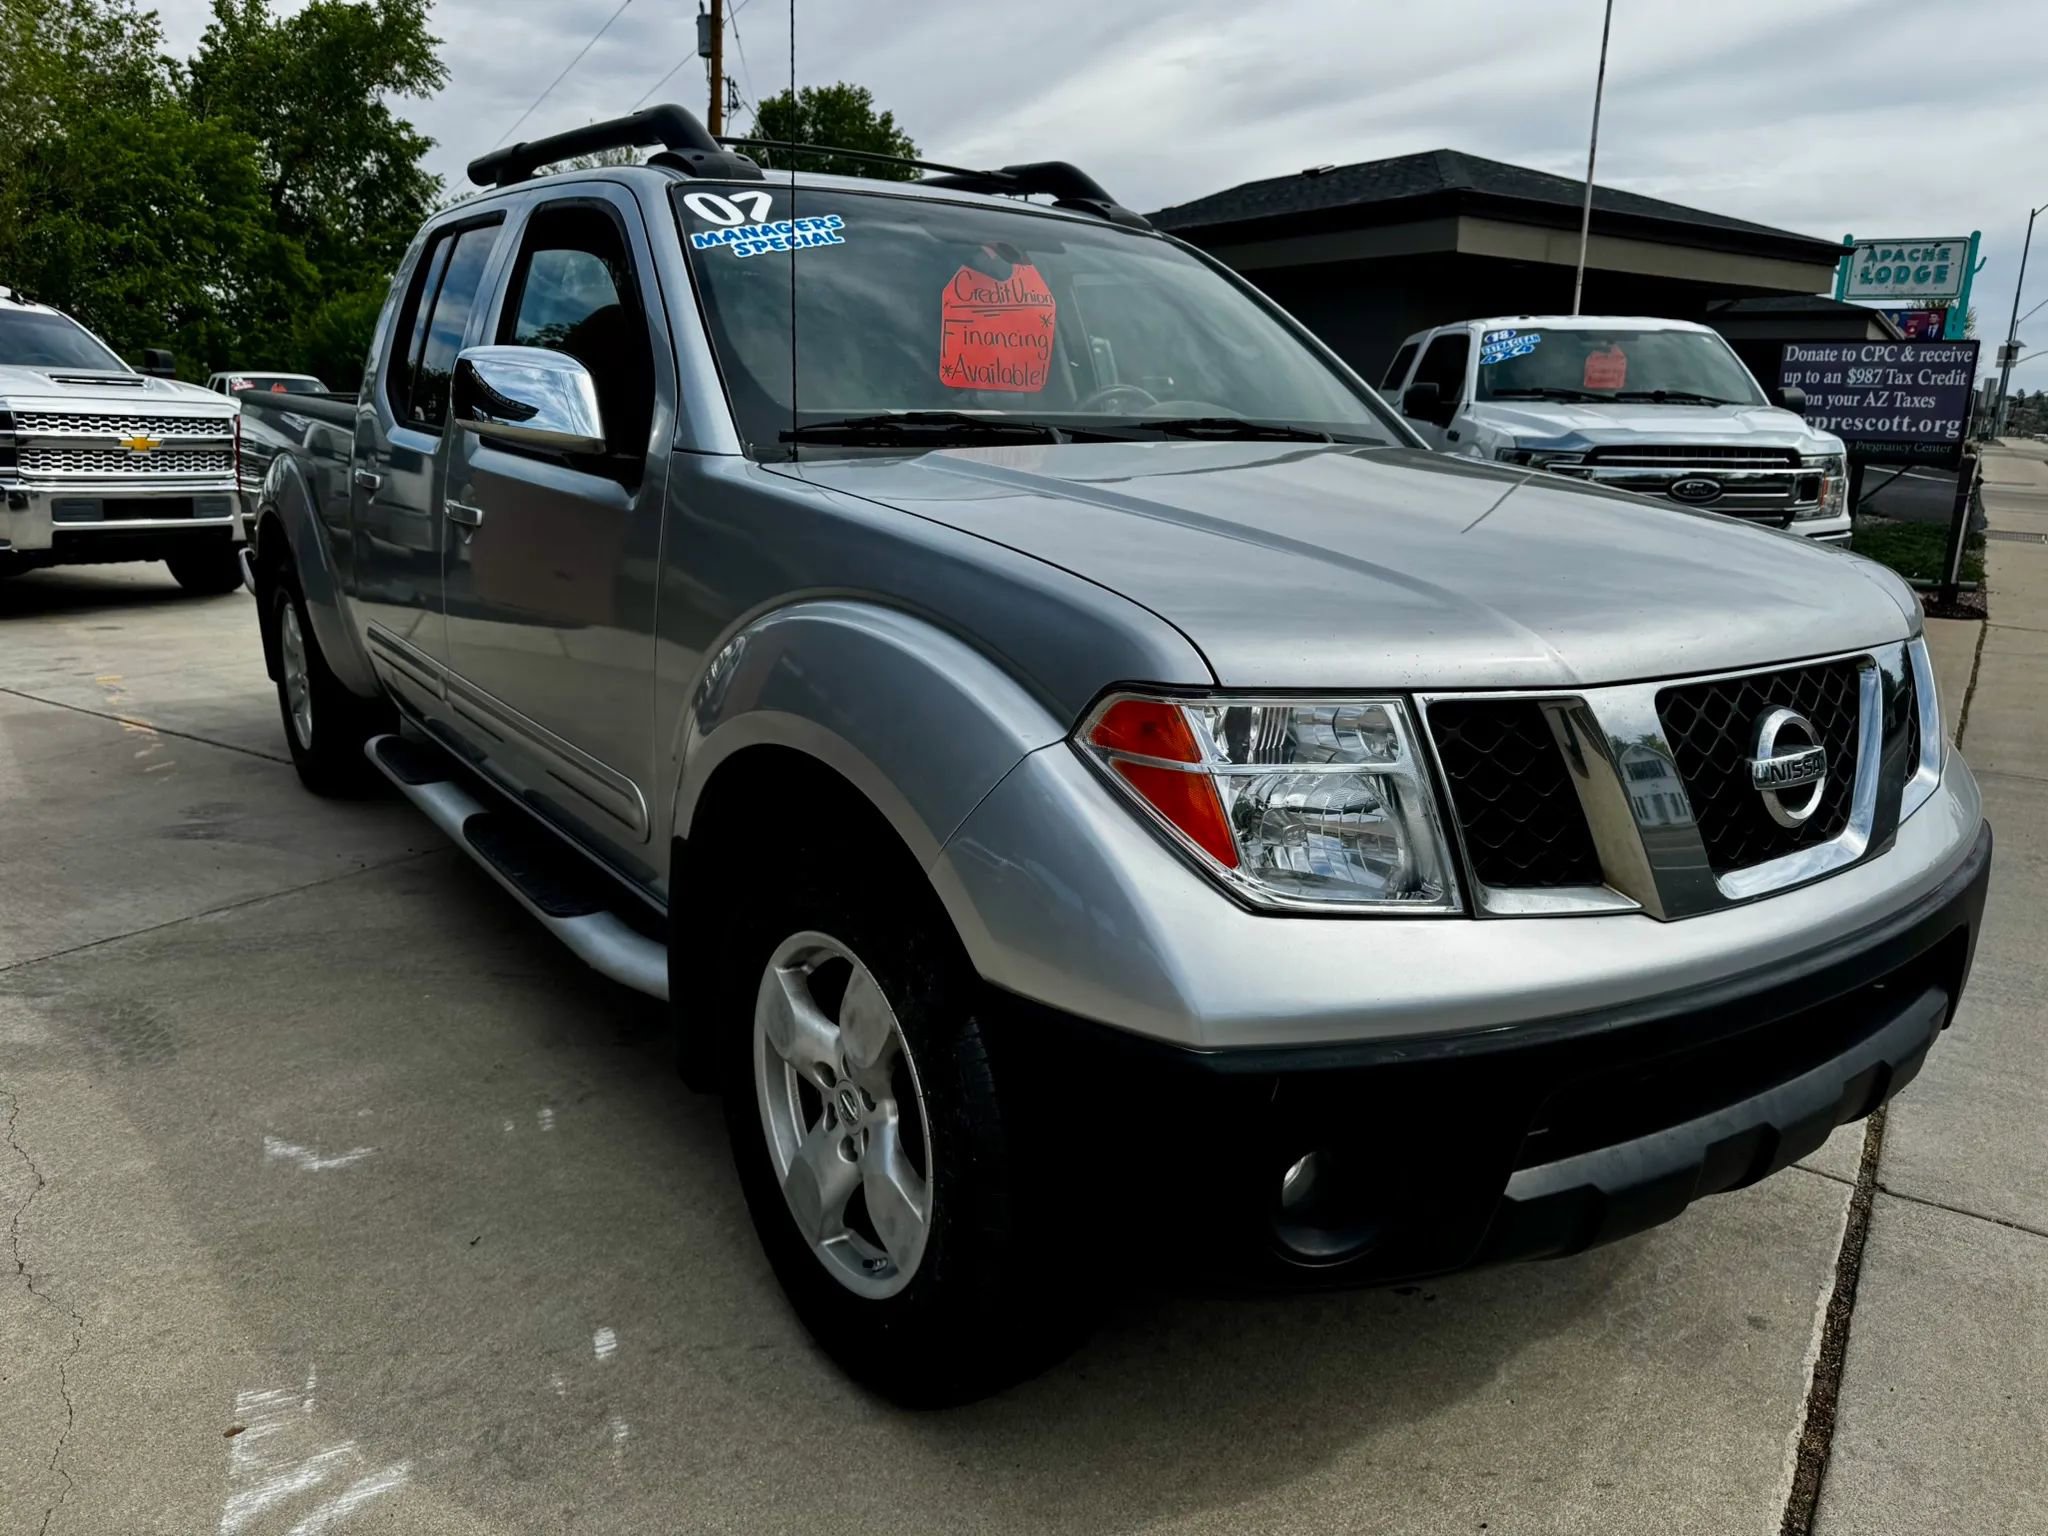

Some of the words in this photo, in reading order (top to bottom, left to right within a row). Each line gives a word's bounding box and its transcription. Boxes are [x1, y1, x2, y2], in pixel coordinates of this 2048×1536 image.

[683, 191, 772, 226] 07
[691, 214, 845, 249] MANAGERS
[733, 229, 845, 258] SPECIAL
[1864, 247, 1951, 262] APACHE
[1860, 264, 1949, 285] LODGE
[954, 270, 1010, 304] Credit
[1011, 277, 1053, 304] Union
[942, 318, 1049, 361] Financing
[1785, 345, 1838, 362] Donate
[1841, 349, 1857, 362] to
[1861, 345, 1898, 362] CPC
[1901, 346, 1914, 362] &
[1919, 346, 1973, 363] receive
[1784, 372, 1801, 387] up
[1805, 370, 1820, 384] to
[1824, 372, 1842, 384] an
[1847, 367, 1883, 385] $987
[1886, 368, 1913, 385] Tax
[1918, 369, 1967, 386] Credit
[1805, 394, 1822, 406] on
[1826, 395, 1861, 409] your
[1863, 391, 1890, 407] AZ
[1894, 392, 1936, 408] Taxes
[1914, 442, 1953, 454] Center
